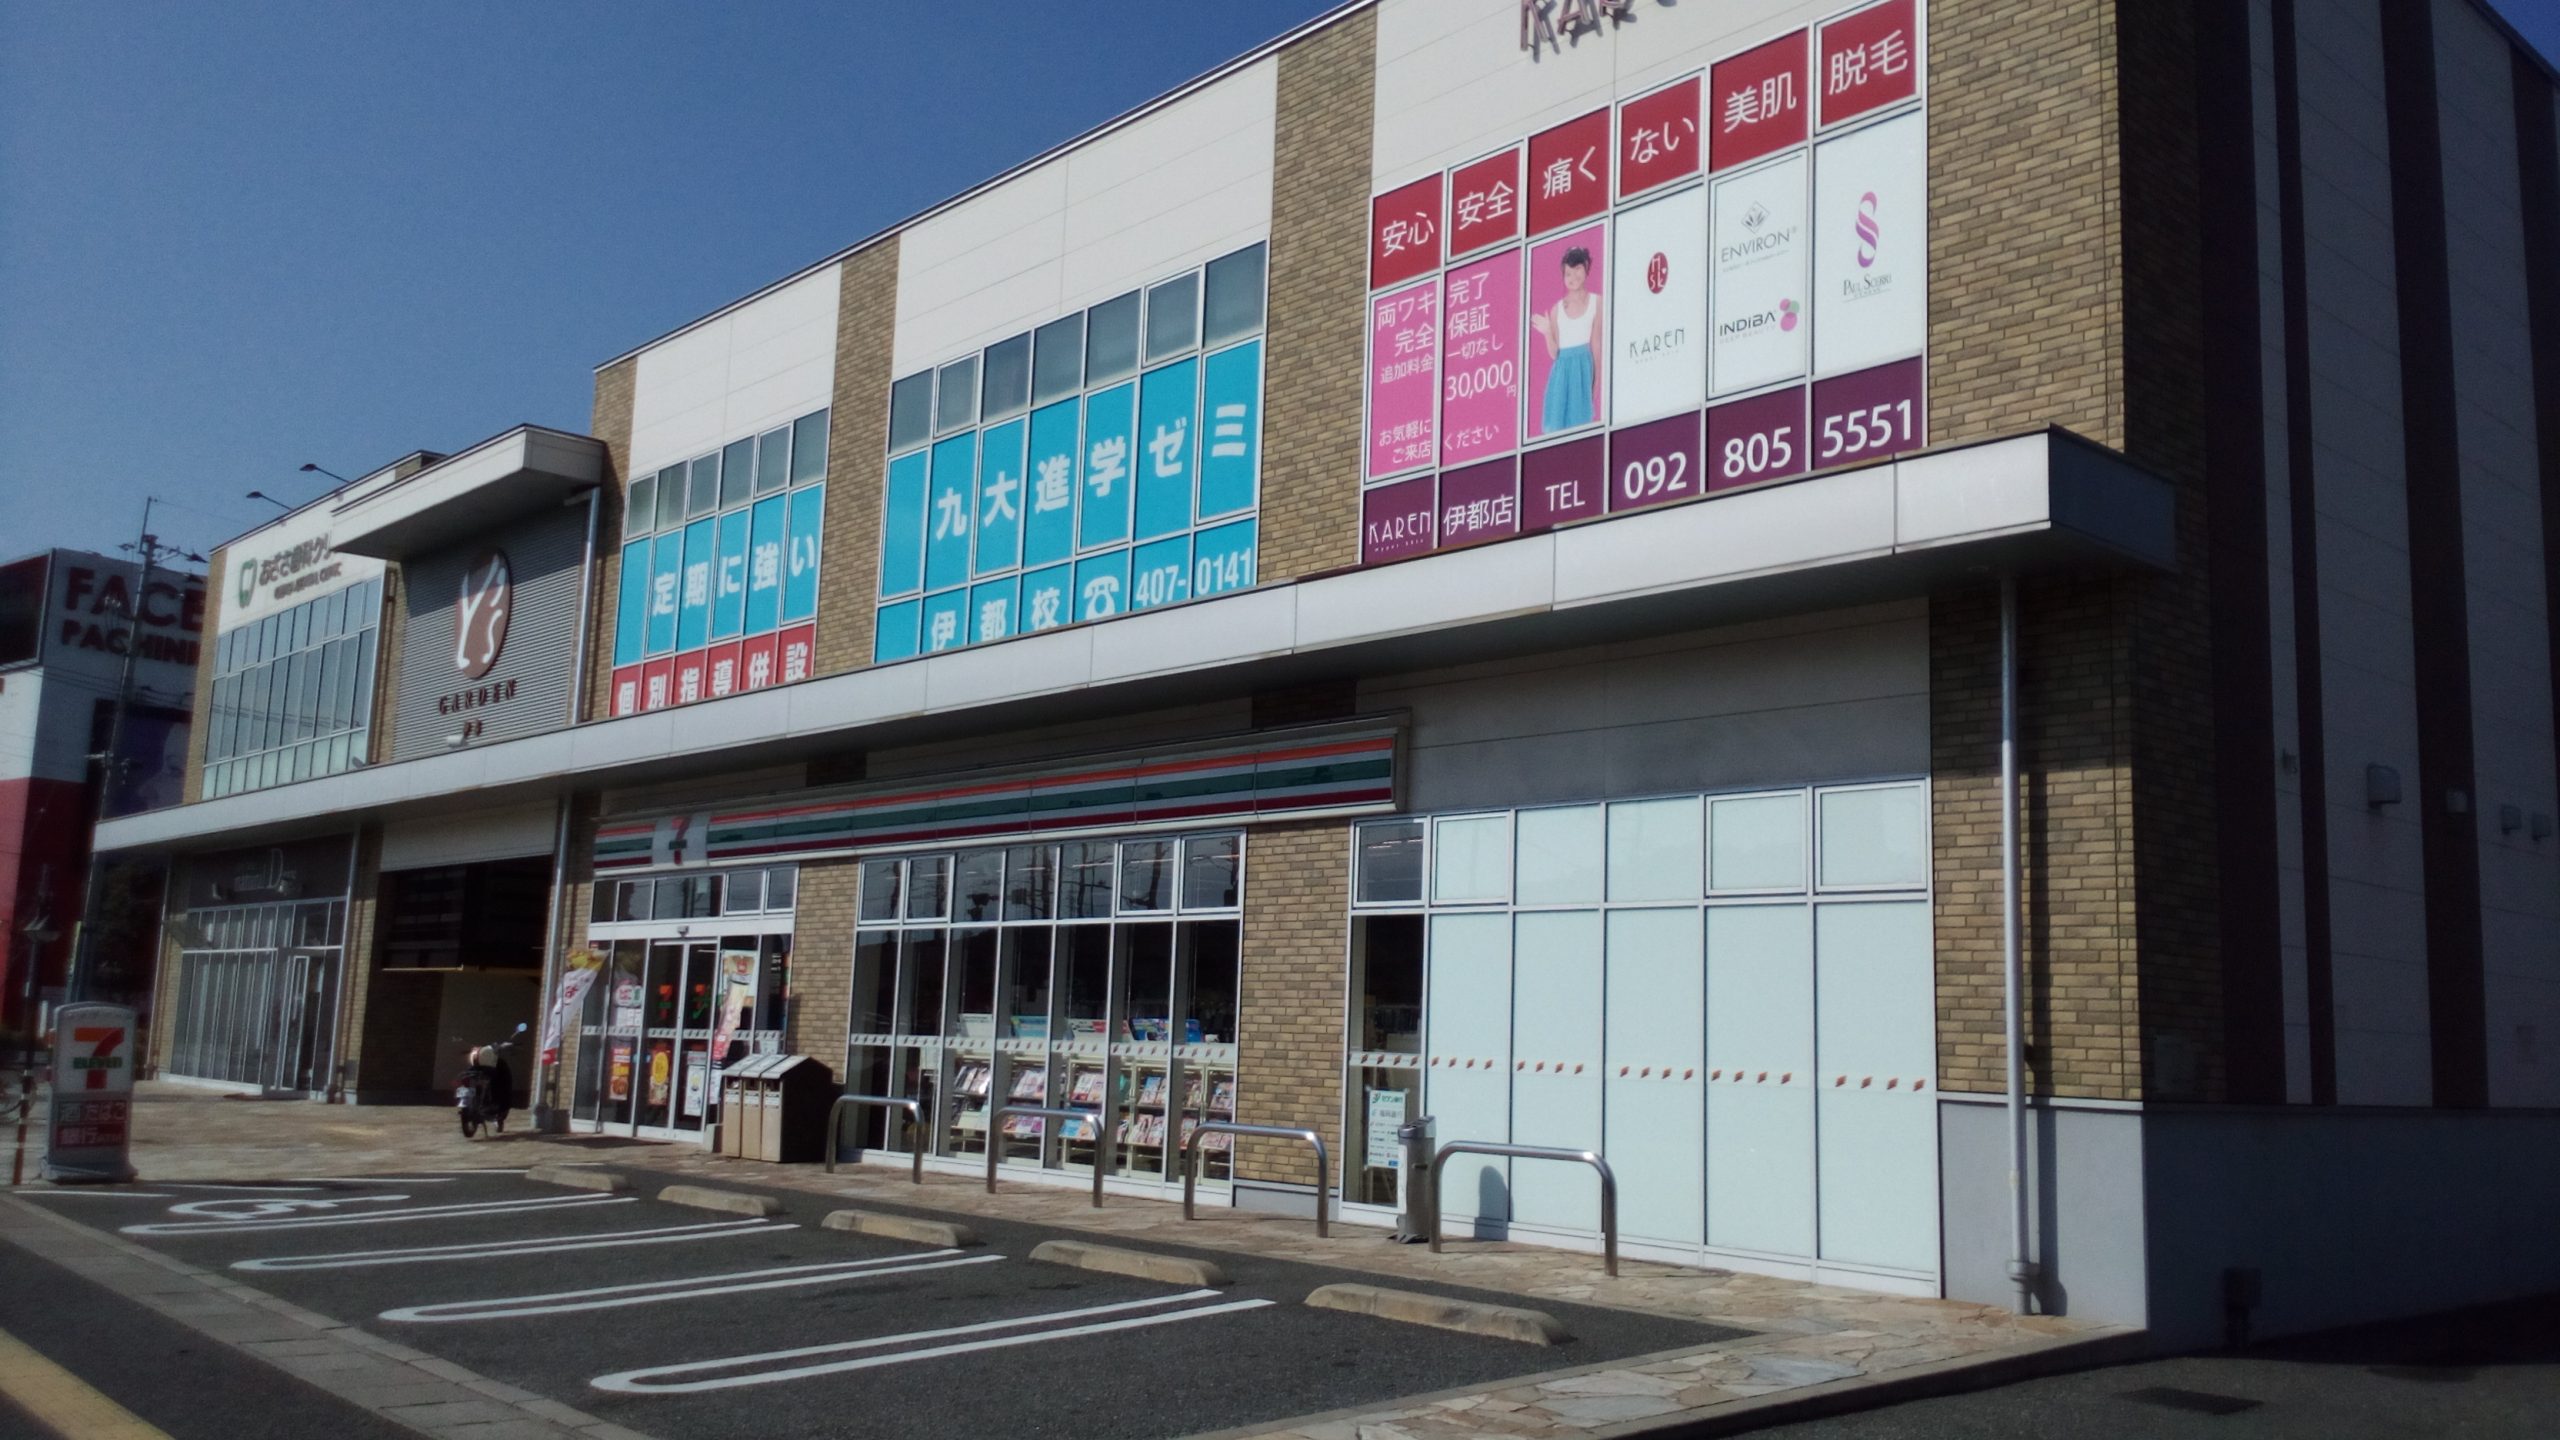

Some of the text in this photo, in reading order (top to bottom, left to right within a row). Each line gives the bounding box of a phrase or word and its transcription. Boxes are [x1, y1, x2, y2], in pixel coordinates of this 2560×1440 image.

[1382, 29, 1908, 258] 安心 安全 痛く ない 美肌 脱毛
[1377, 272, 1490, 331] 両ワキ 完了
[1395, 303, 1490, 357] 完全 保証
[1629, 327, 1685, 359] KAREN
[936, 404, 1246, 541] 九大進学ゼミ
[1369, 399, 1912, 545] KAREN 伊都店 TEL 092 805 5551
[66, 566, 206, 632] FACE
[652, 534, 815, 616] 定期に強い
[931, 587, 1061, 651] 伊都校
[618, 642, 808, 716] 個別指導併設
